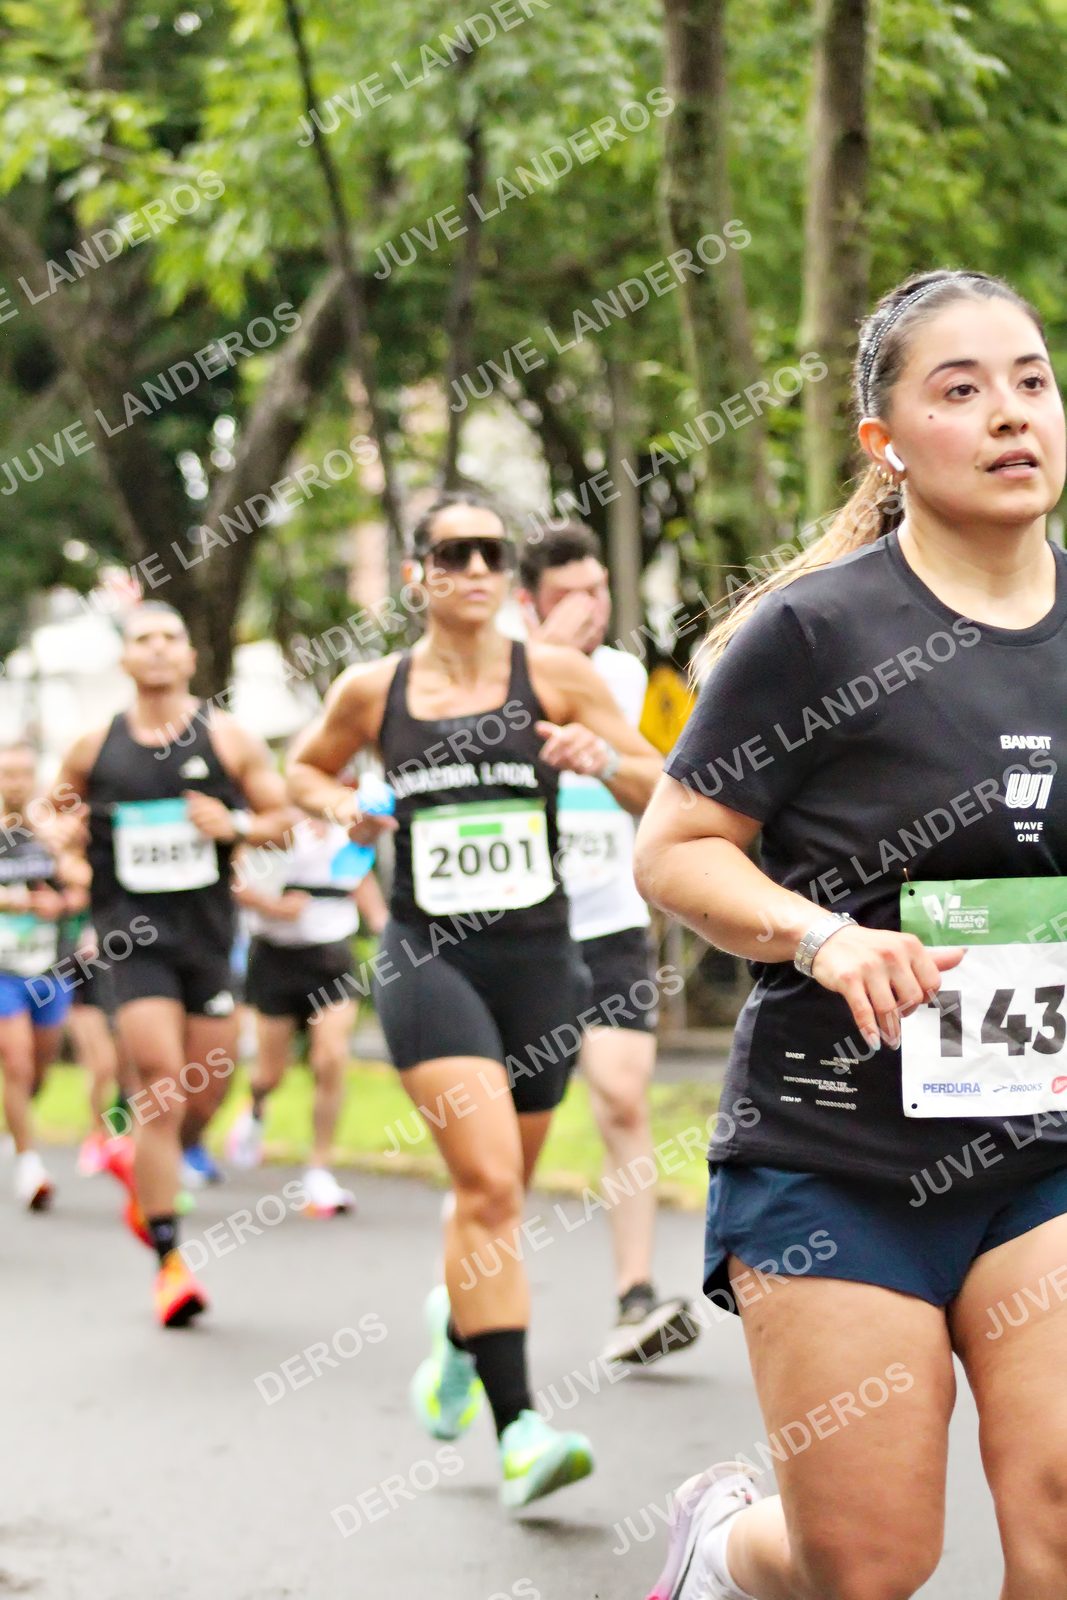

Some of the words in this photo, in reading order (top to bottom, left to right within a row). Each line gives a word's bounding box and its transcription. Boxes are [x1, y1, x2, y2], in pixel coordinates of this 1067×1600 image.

[1000, 735, 1051, 750] BANDIT
[1014, 821, 1043, 831] WAVE
[1017, 834, 1039, 842] ONE
[429, 839, 535, 879] 2001
[949, 915, 974, 923] ATLAS
[928, 985, 1067, 1057] 143
[922, 1082, 981, 1094] PERDURA
[1010, 1083, 1043, 1093] BROOKS
